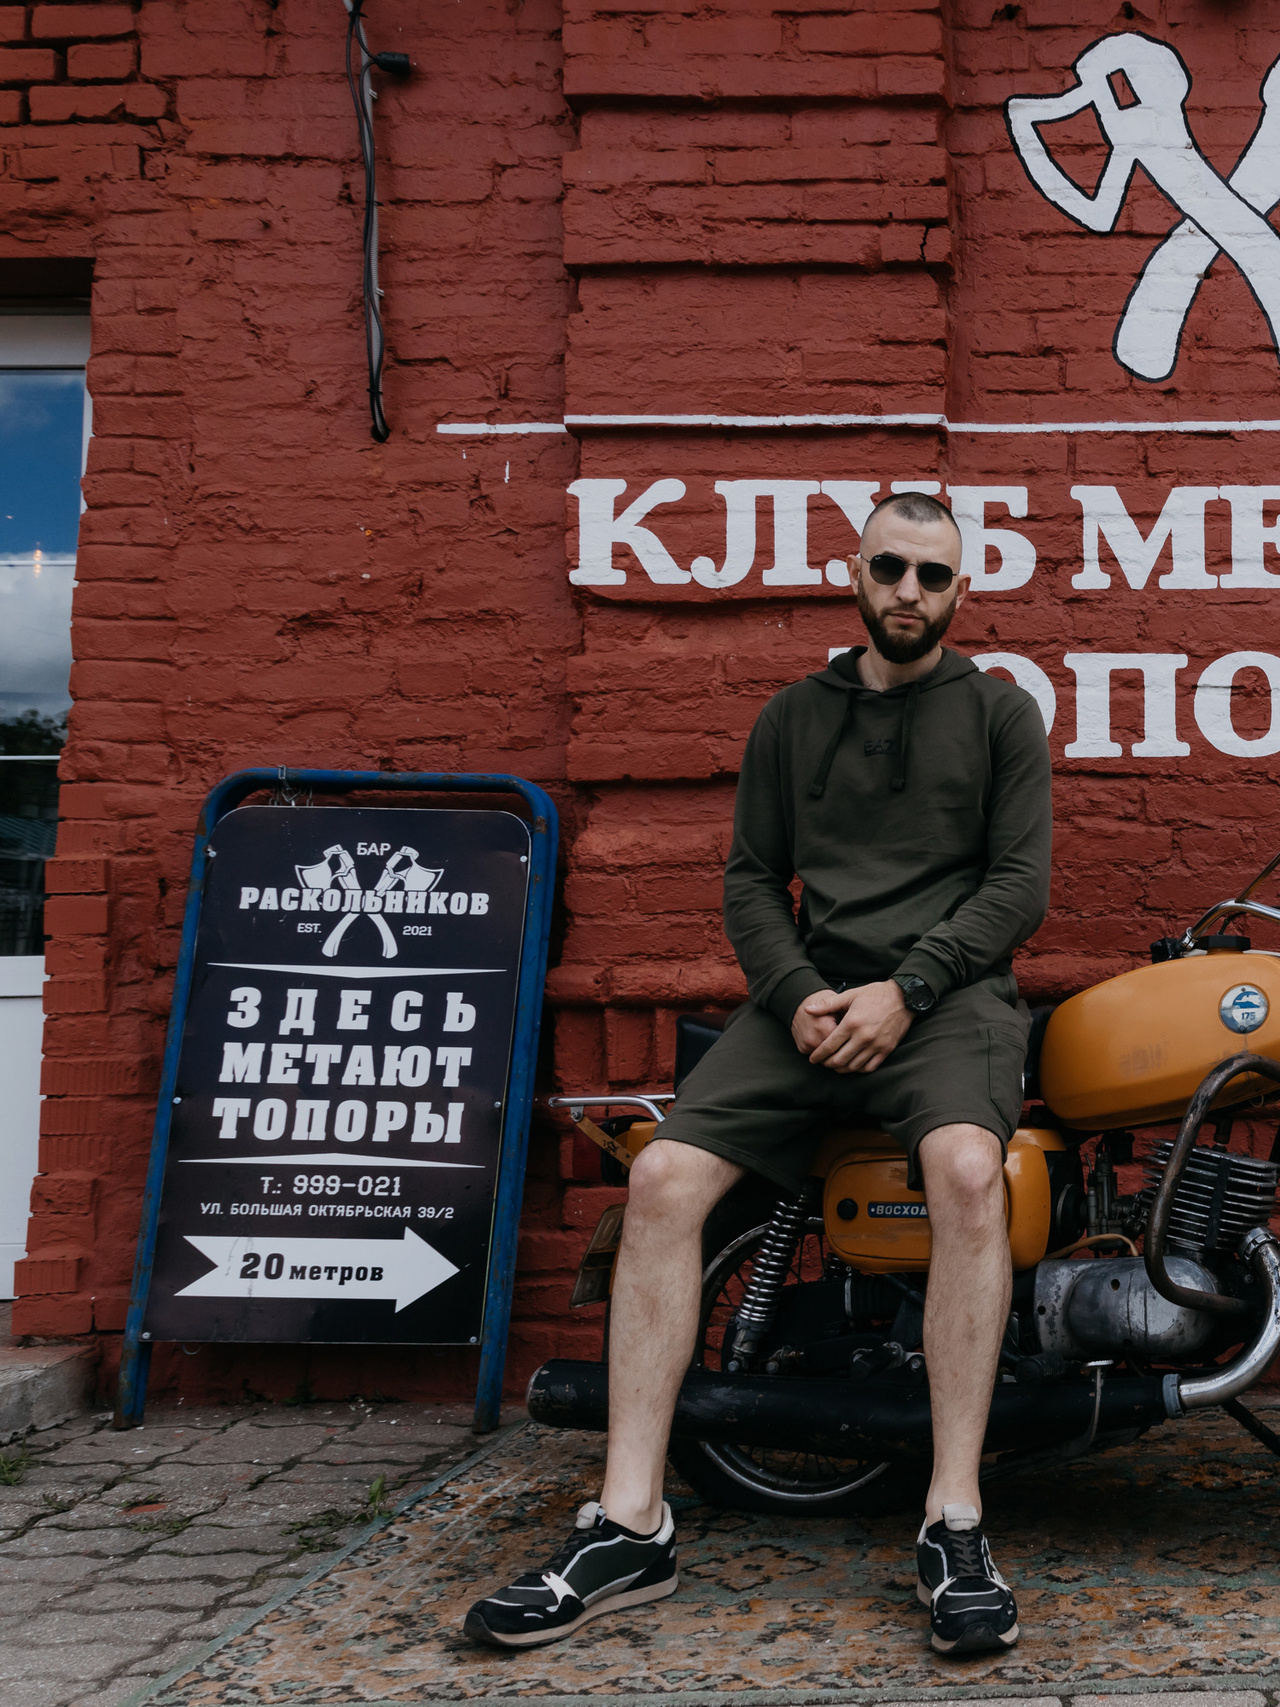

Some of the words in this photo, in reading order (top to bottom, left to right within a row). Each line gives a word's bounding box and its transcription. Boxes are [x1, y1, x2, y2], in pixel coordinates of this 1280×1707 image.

[356, 842, 392, 857] БАР
[238, 886, 490, 916] РАСКОЛЬНИКОВ
[296, 922, 322, 934] EST.
[402, 924, 433, 936] 2021
[218, 1041, 473, 1088] МЕТАЮТ
[211, 1097, 465, 1144] ТОПОРЫ
[292, 1174, 401, 1197] 999-021
[200, 1202, 224, 1215] УЛ.
[230, 1203, 303, 1217] БОЛЬШАЯ
[308, 1205, 412, 1219] ОКТЯБРЬСКАЯ
[417, 1206, 455, 1219] 39/2
[239, 1252, 285, 1280] 20
[289, 1264, 384, 1286] метров
